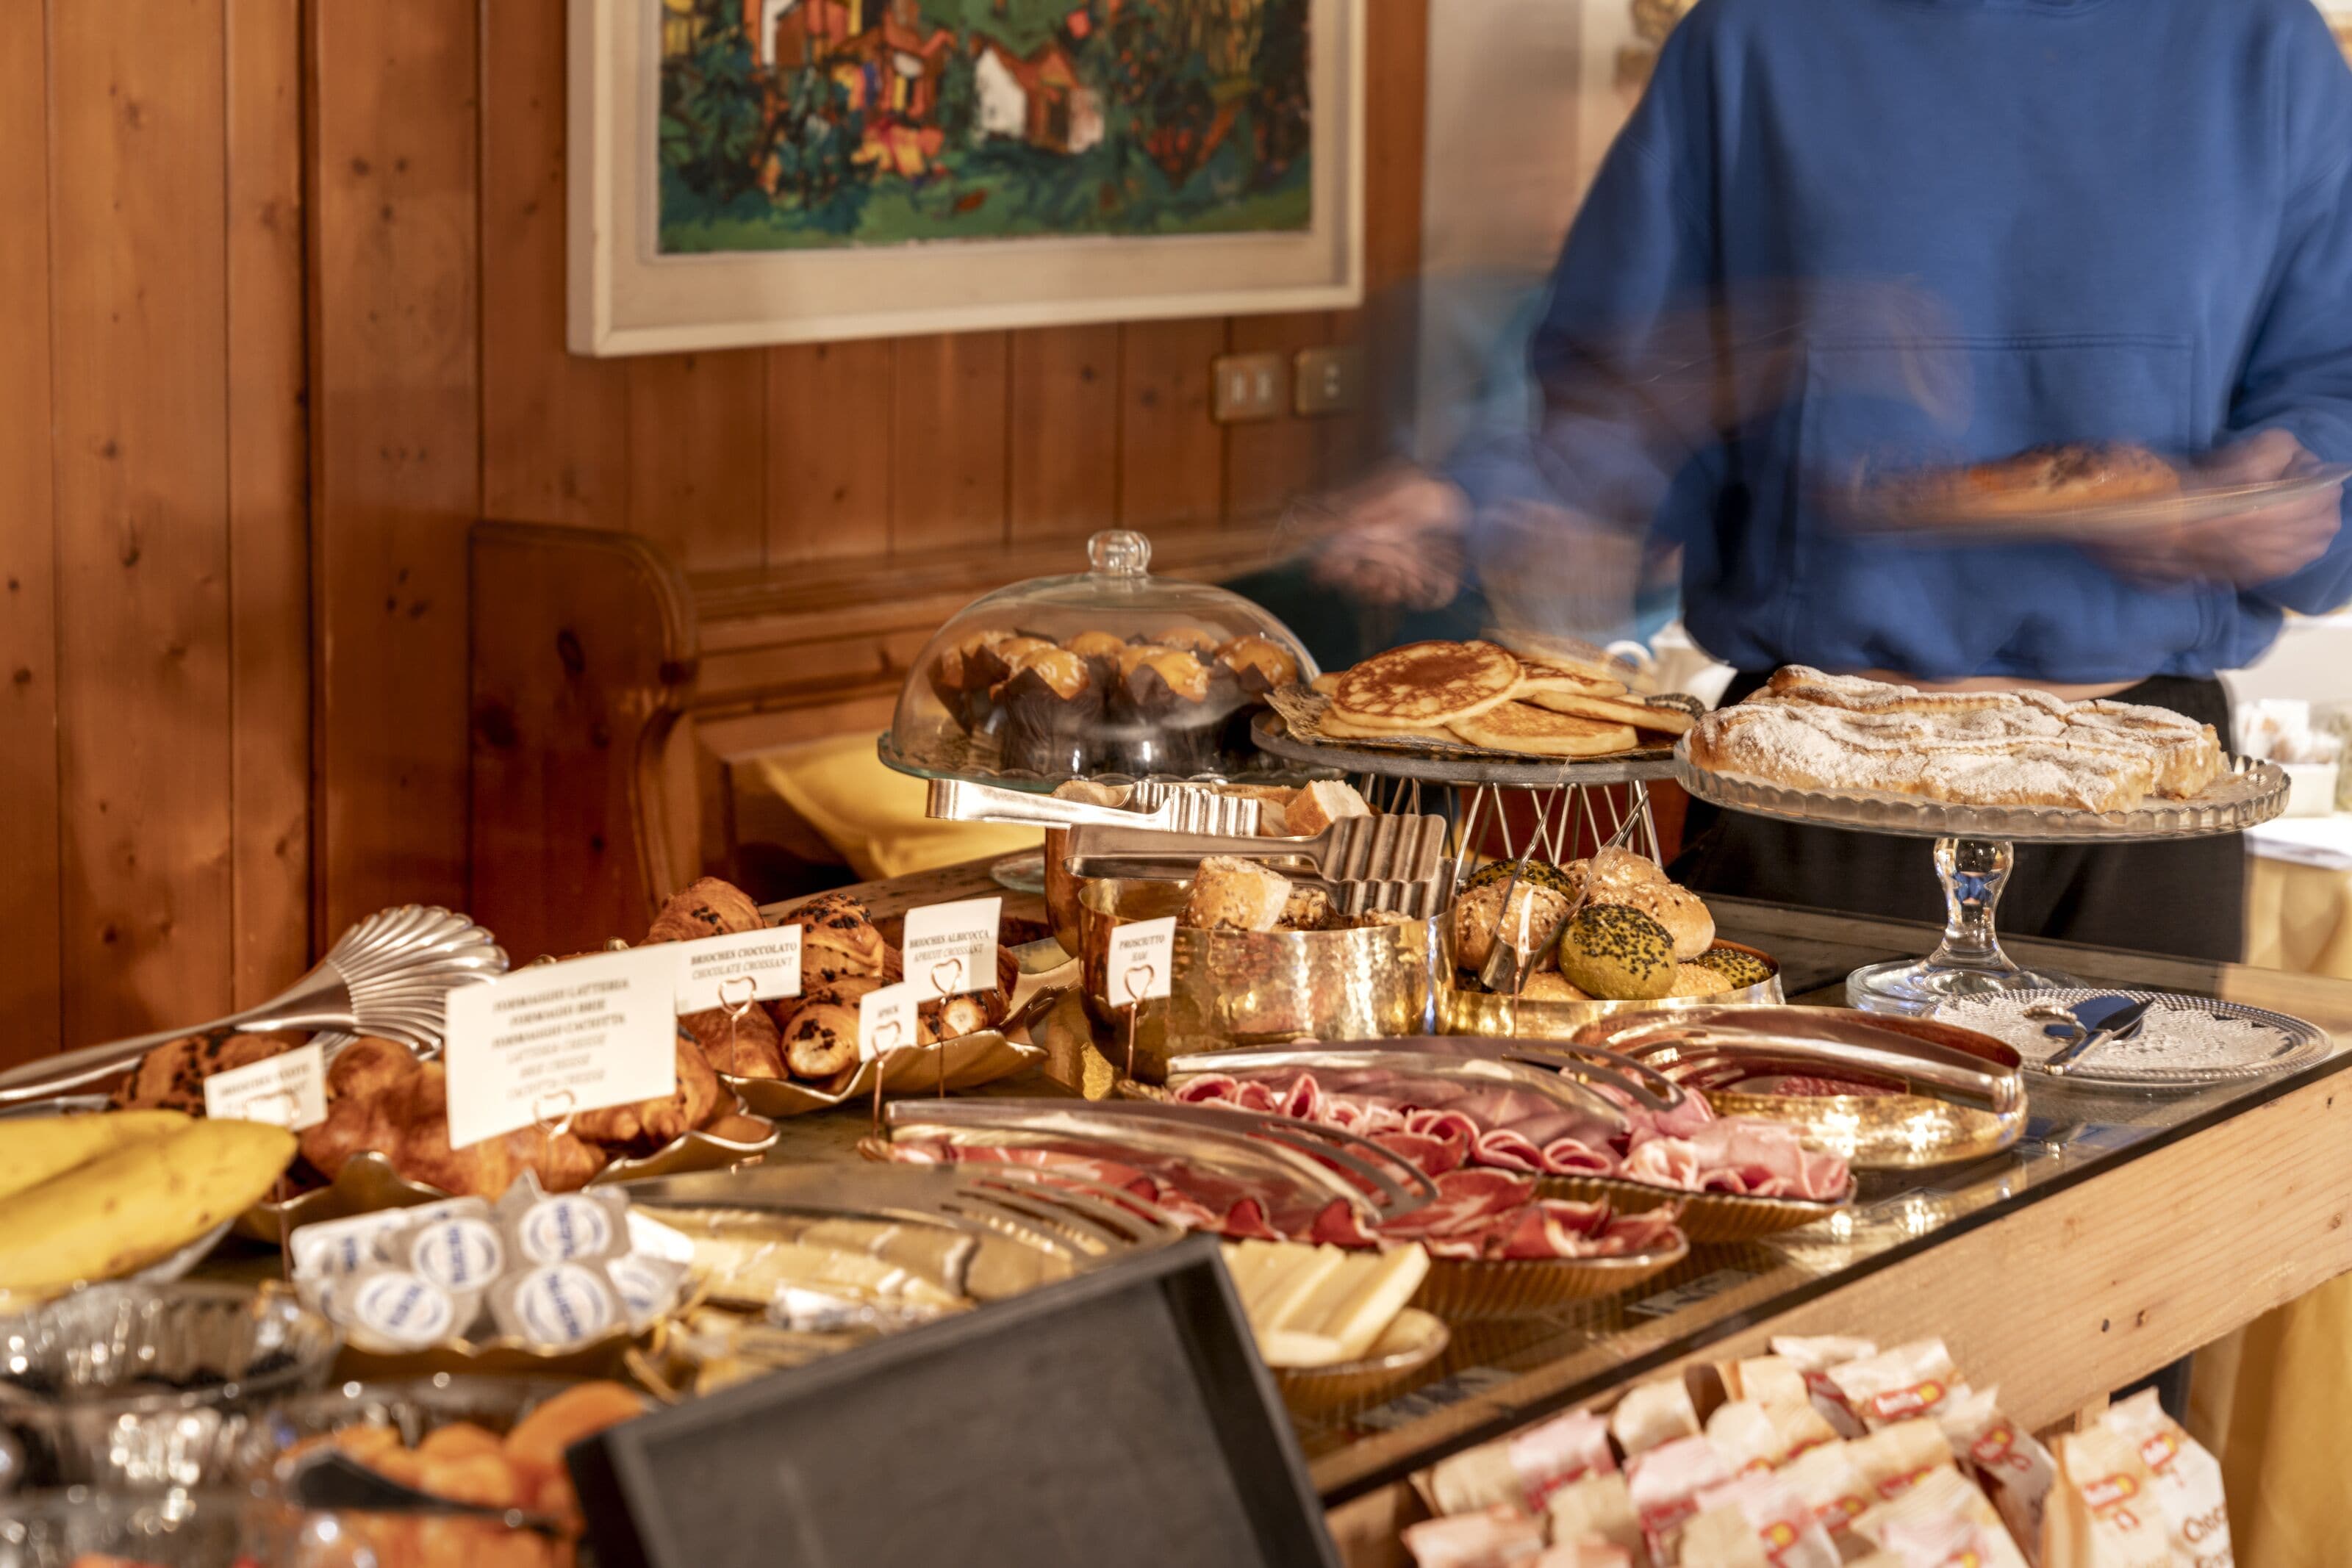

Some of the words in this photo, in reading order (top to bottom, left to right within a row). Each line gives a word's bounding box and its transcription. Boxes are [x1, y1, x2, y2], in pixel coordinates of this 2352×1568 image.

[909, 935, 945, 949] BRIOCHES
[947, 929, 989, 943] ALBICOCCA
[1119, 934, 1165, 949] PROSCIUTTO
[691, 950, 735, 965] BRIOCHES
[738, 942, 797, 958] CIOCCOLATO
